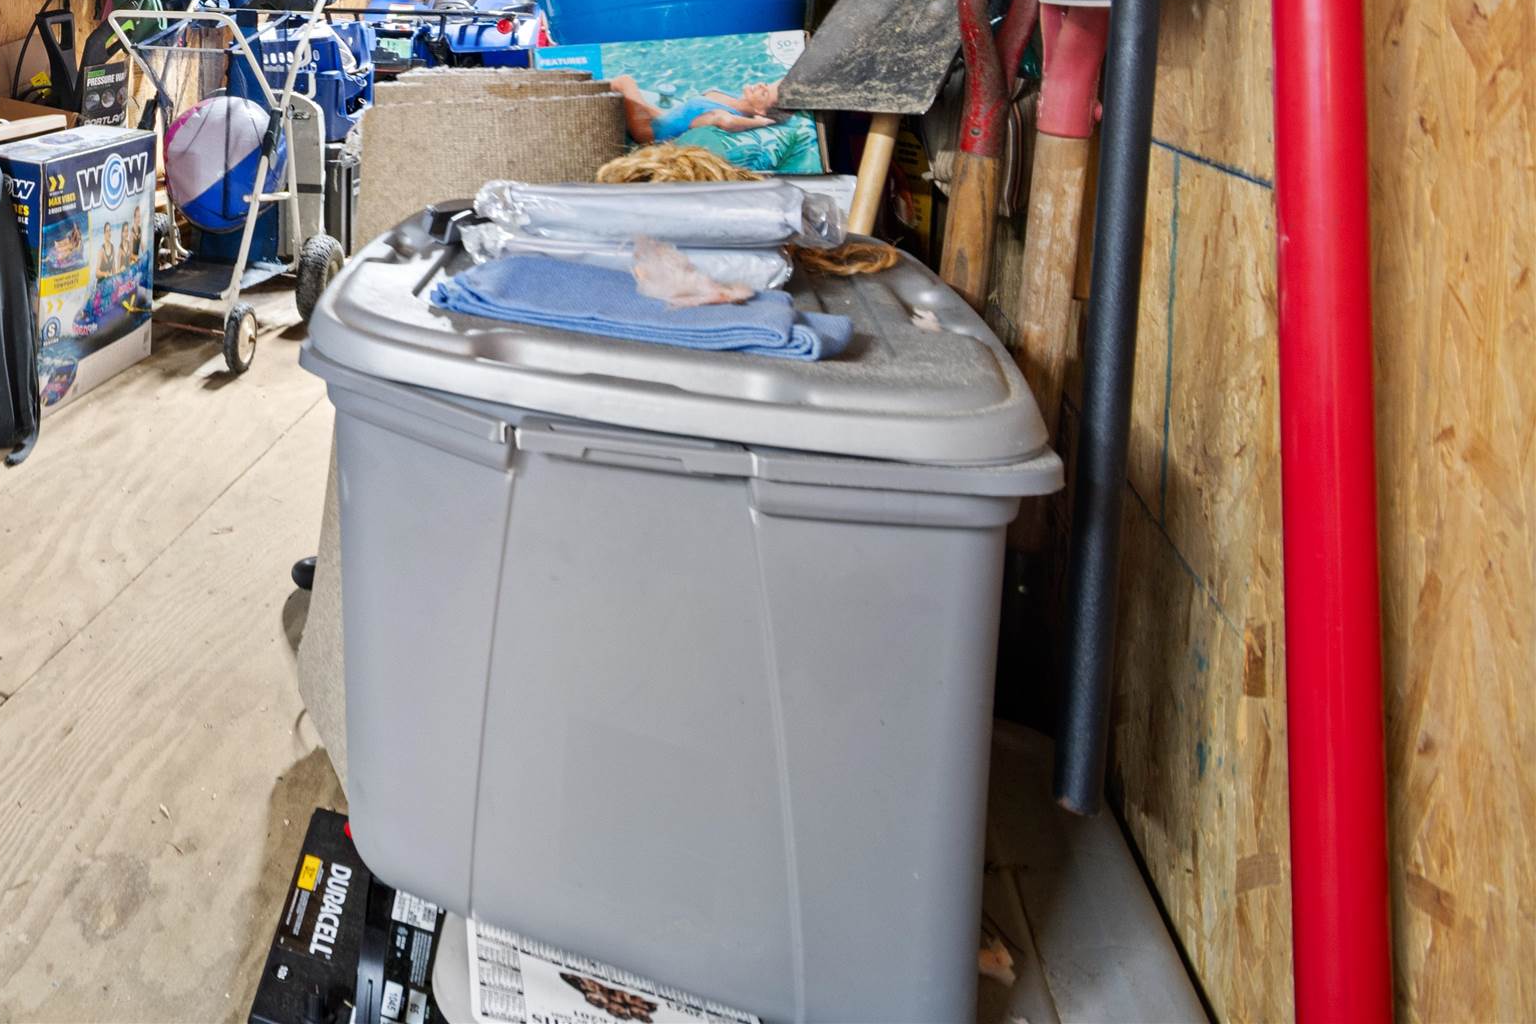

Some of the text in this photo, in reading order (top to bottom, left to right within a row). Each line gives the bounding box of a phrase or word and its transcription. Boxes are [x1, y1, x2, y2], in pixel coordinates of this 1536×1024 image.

[539, 55, 589, 68] FEATURES
[86, 73, 115, 88] PRESSURE
[75, 151, 149, 212] WOW
[48, 196, 62, 208] MAX
[308, 862, 352, 960] DURACELL
